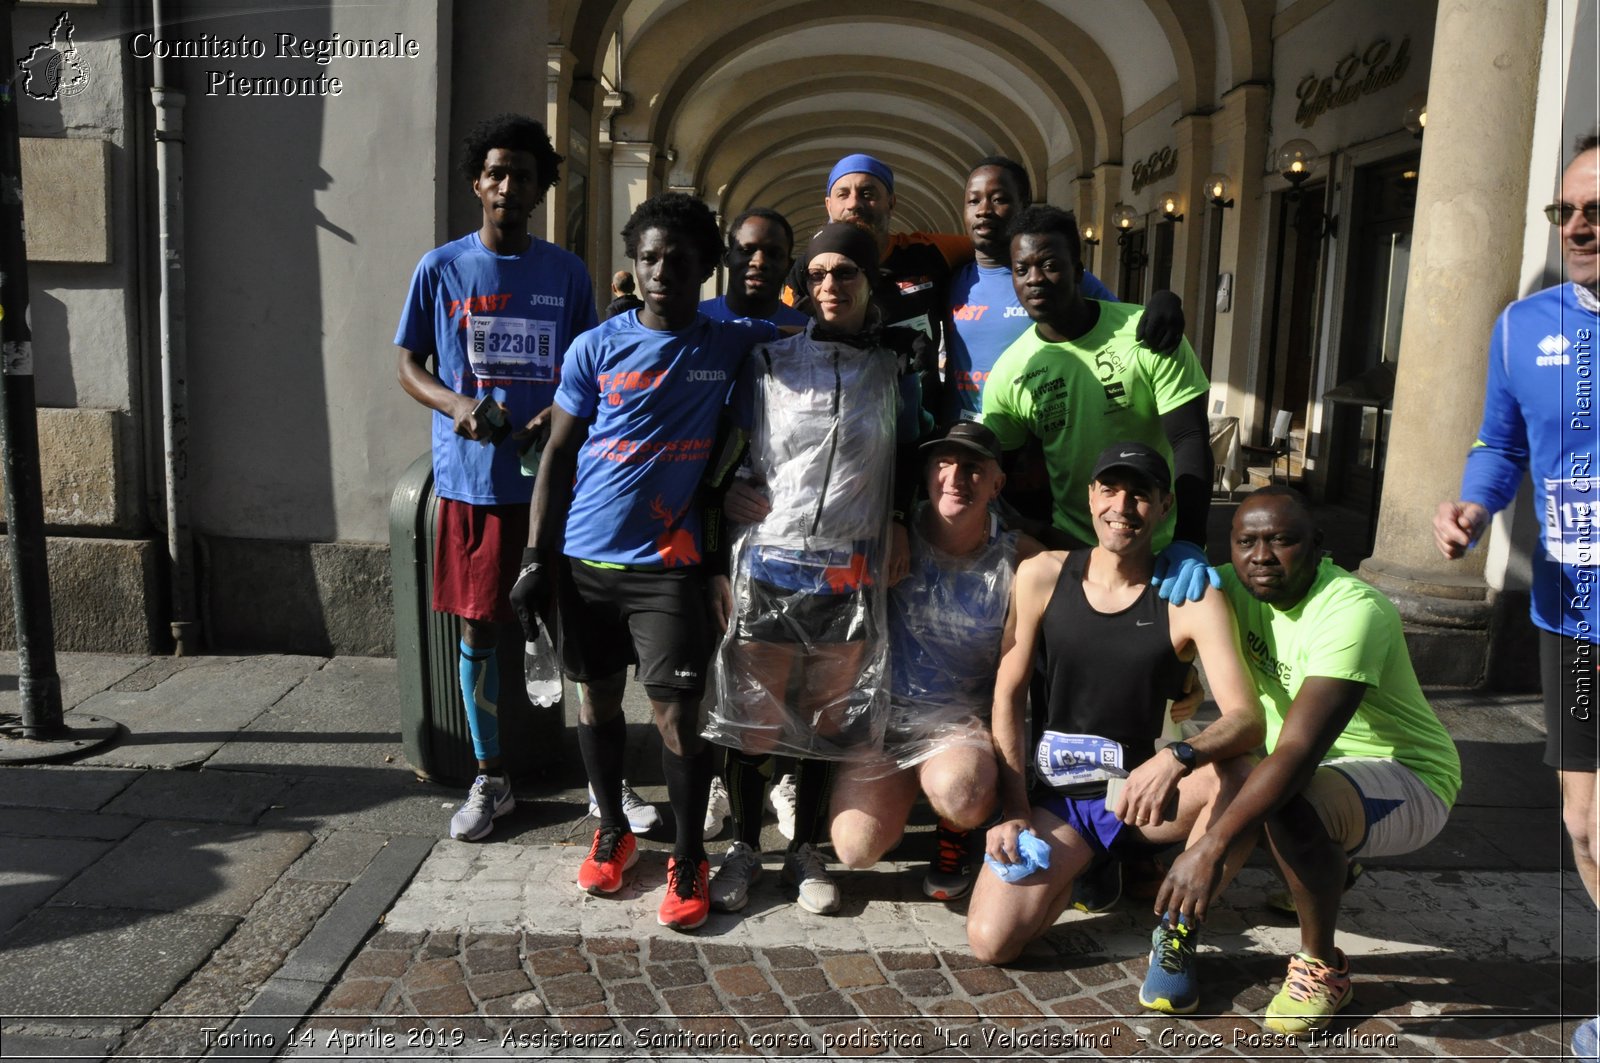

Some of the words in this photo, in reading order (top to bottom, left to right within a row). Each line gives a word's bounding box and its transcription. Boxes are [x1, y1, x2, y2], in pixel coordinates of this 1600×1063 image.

[489, 333, 536, 354] 3230
[1095, 350, 1114, 382] 5
[597, 370, 669, 393] T-FAST
[1053, 749, 1096, 766] 1327
